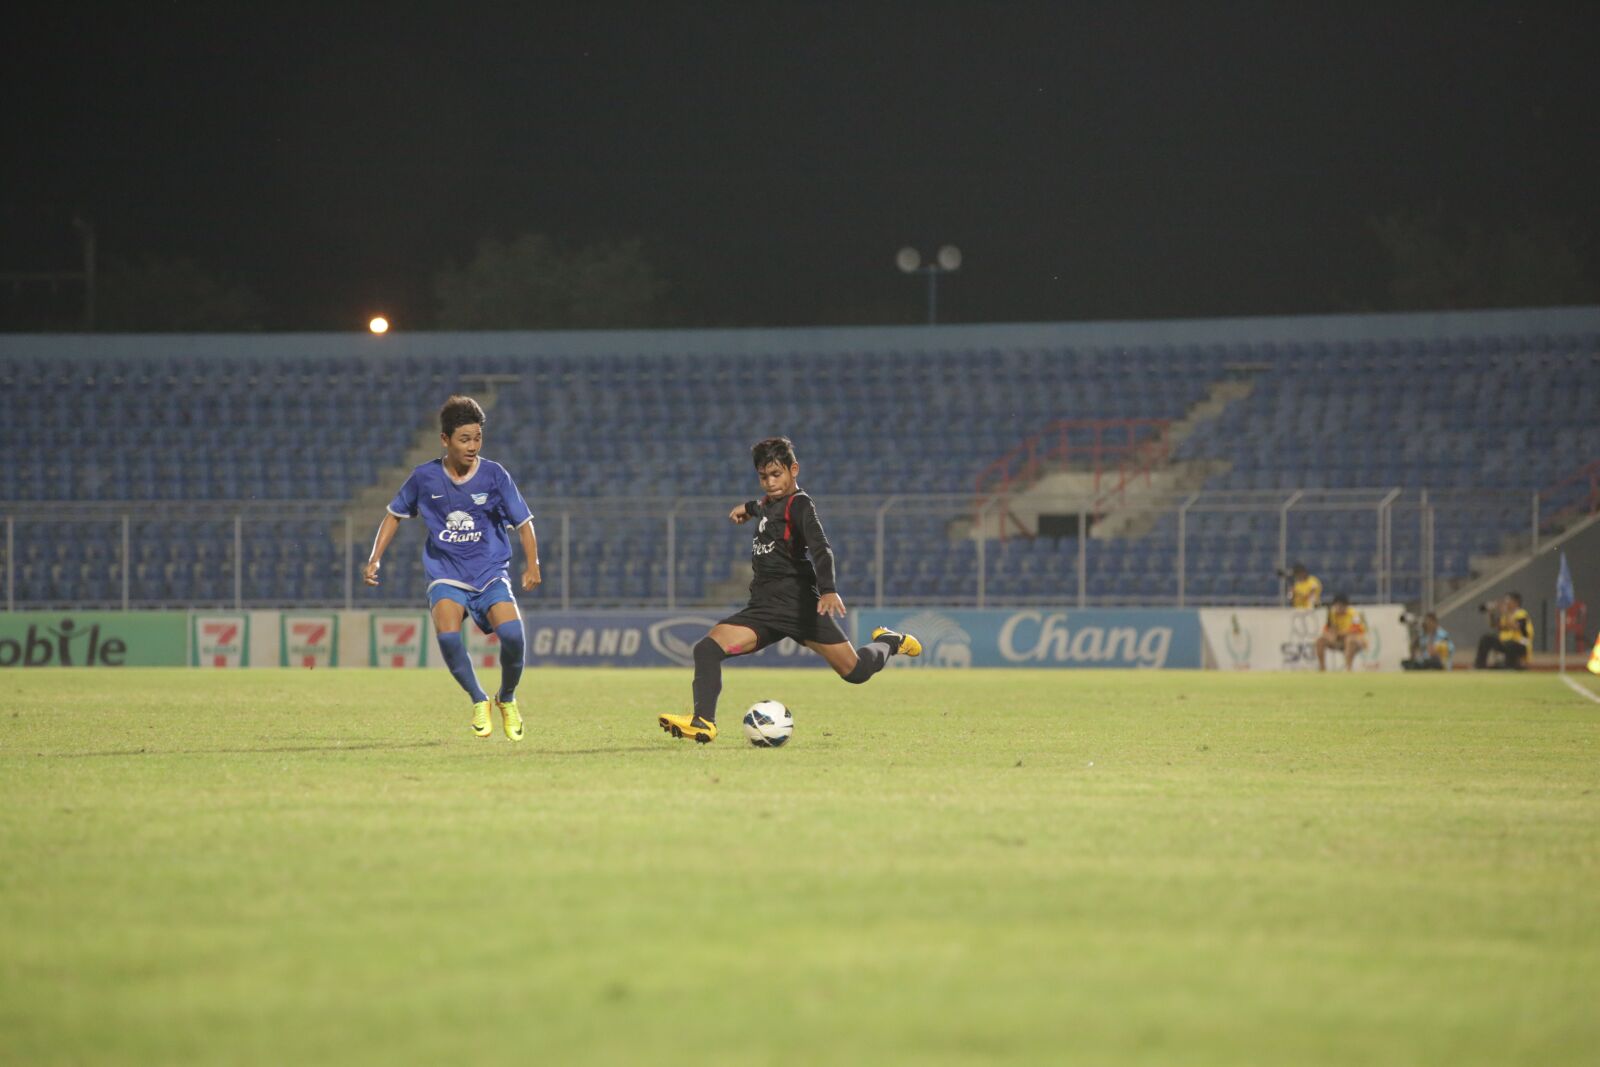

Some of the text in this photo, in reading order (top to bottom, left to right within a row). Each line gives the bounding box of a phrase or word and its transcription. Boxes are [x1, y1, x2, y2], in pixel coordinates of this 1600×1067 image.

[438, 529, 482, 542] Chang
[533, 628, 641, 656] GRAND
[997, 610, 1174, 669] Chang
